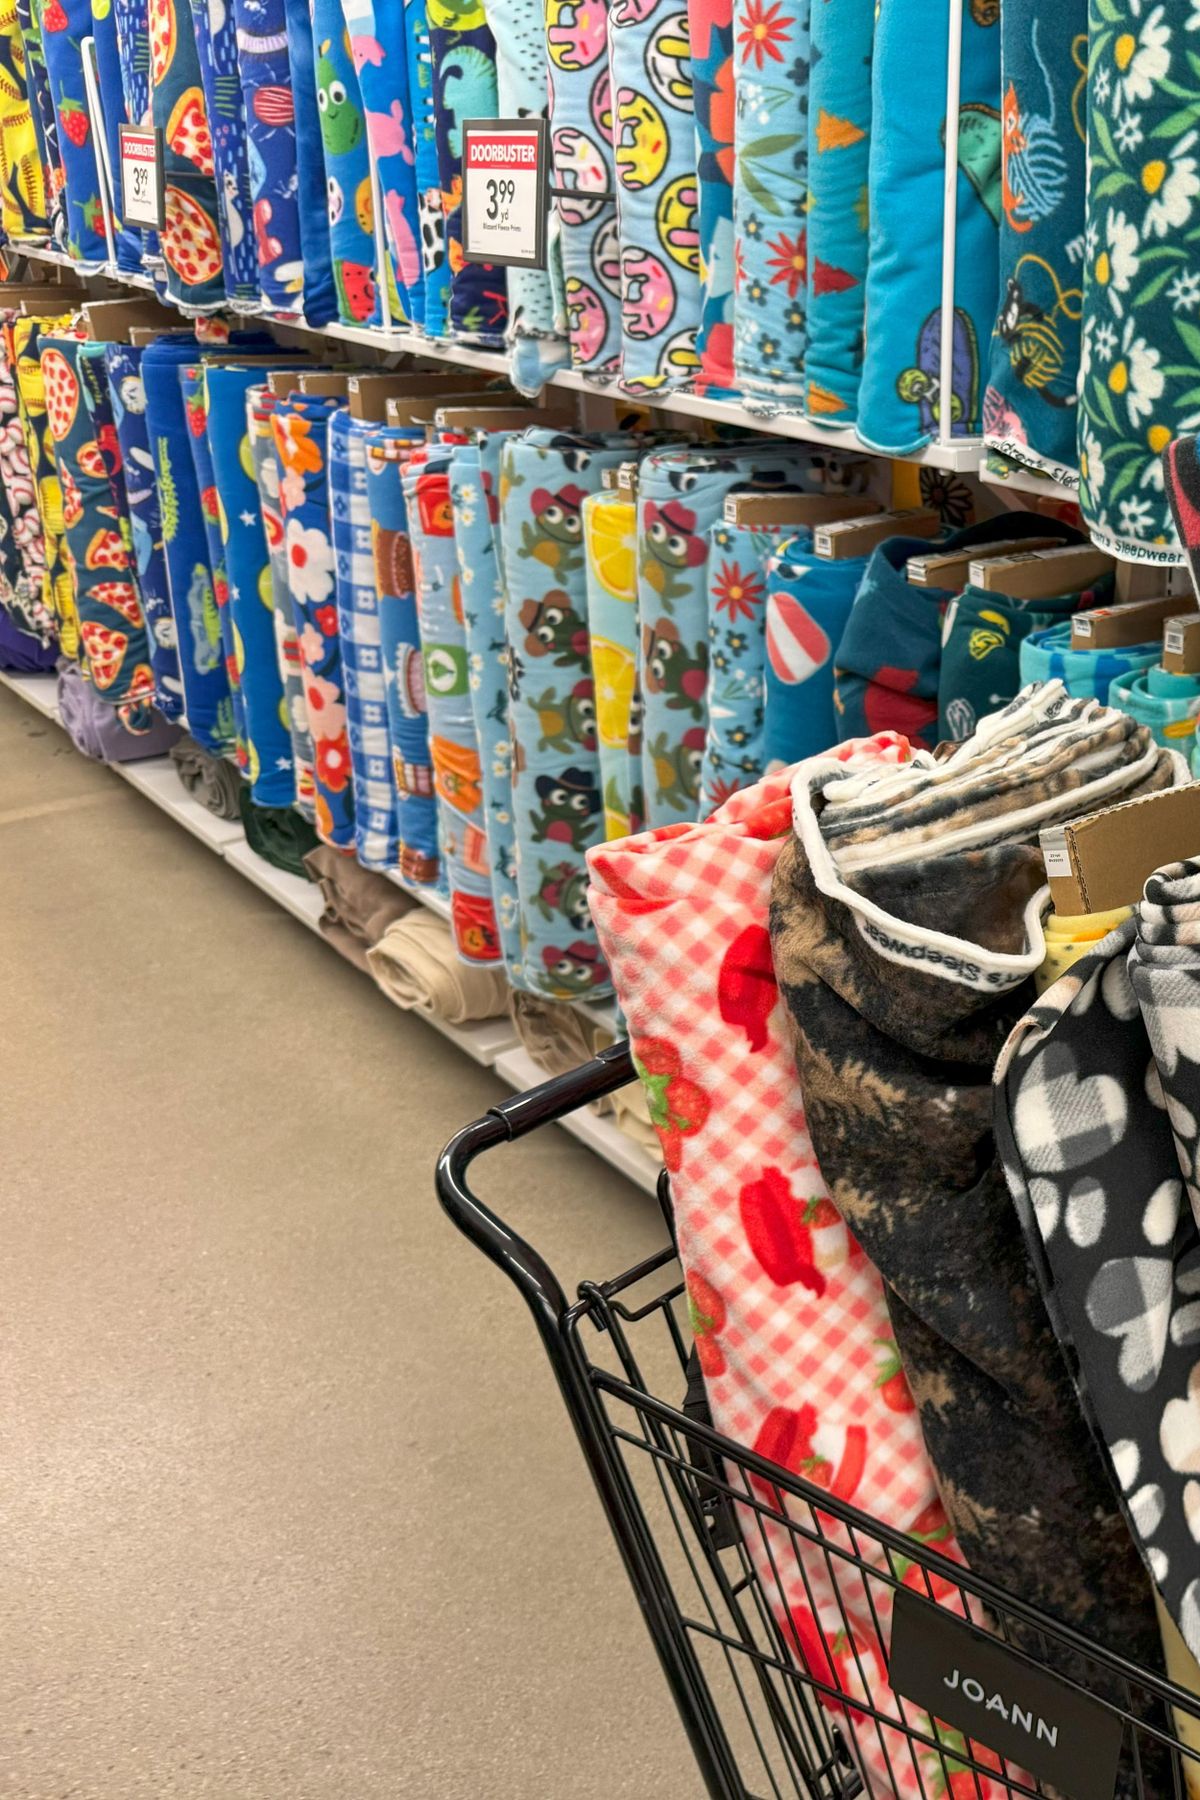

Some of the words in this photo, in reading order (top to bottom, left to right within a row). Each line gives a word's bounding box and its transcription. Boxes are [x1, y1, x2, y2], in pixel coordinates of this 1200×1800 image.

[124, 142, 156, 158] DOORBUSTE
[471, 144, 535, 162] DOORBUSTER
[501, 209, 509, 223] yd
[1115, 540, 1184, 563] Sleepwear
[864, 919, 981, 982] Sleepwear
[944, 1670, 1058, 1748] JOANN
